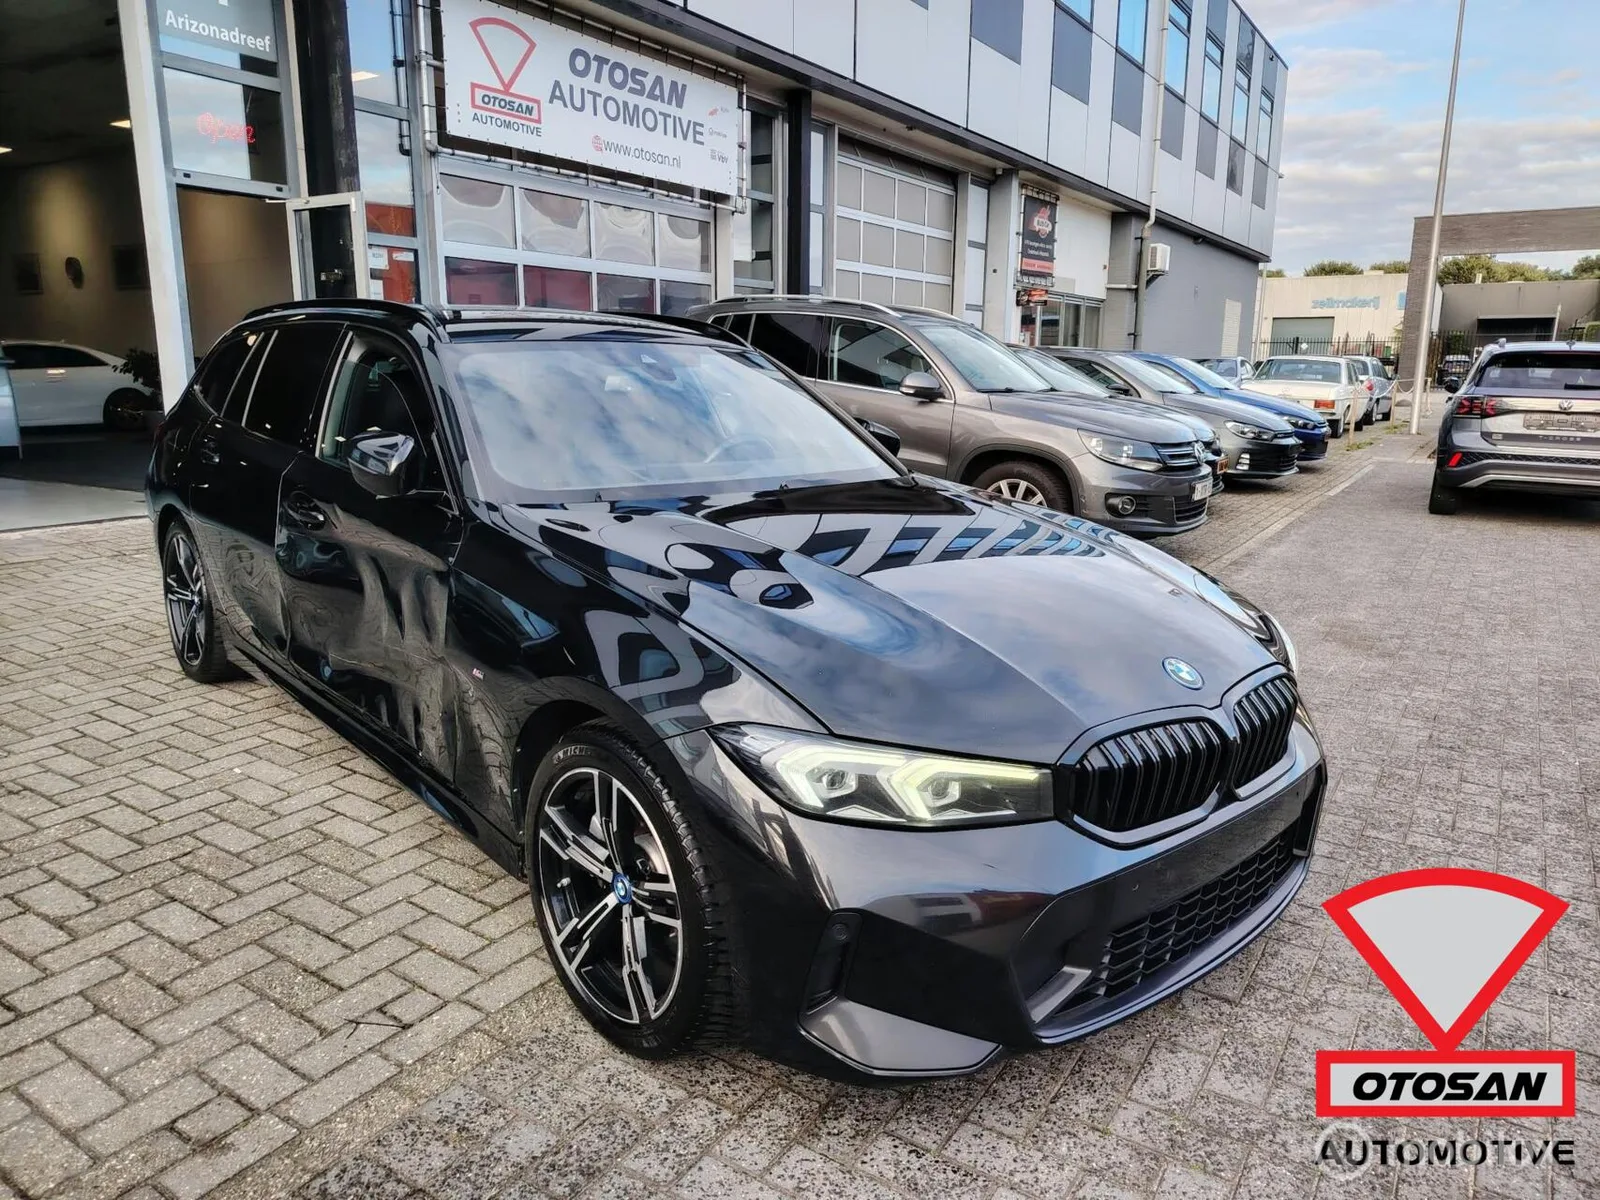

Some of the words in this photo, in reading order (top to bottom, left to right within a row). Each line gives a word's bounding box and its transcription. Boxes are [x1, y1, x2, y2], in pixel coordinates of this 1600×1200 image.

[165, 9, 271, 52] Arizonadreef
[568, 48, 687, 109] OTOSAN
[481, 94, 534, 117] OTOSAN
[548, 79, 705, 146] AUTOMOTIVE
[472, 112, 542, 138] AUTOMOTIVE
[603, 139, 682, 169] www.otosan.nl
